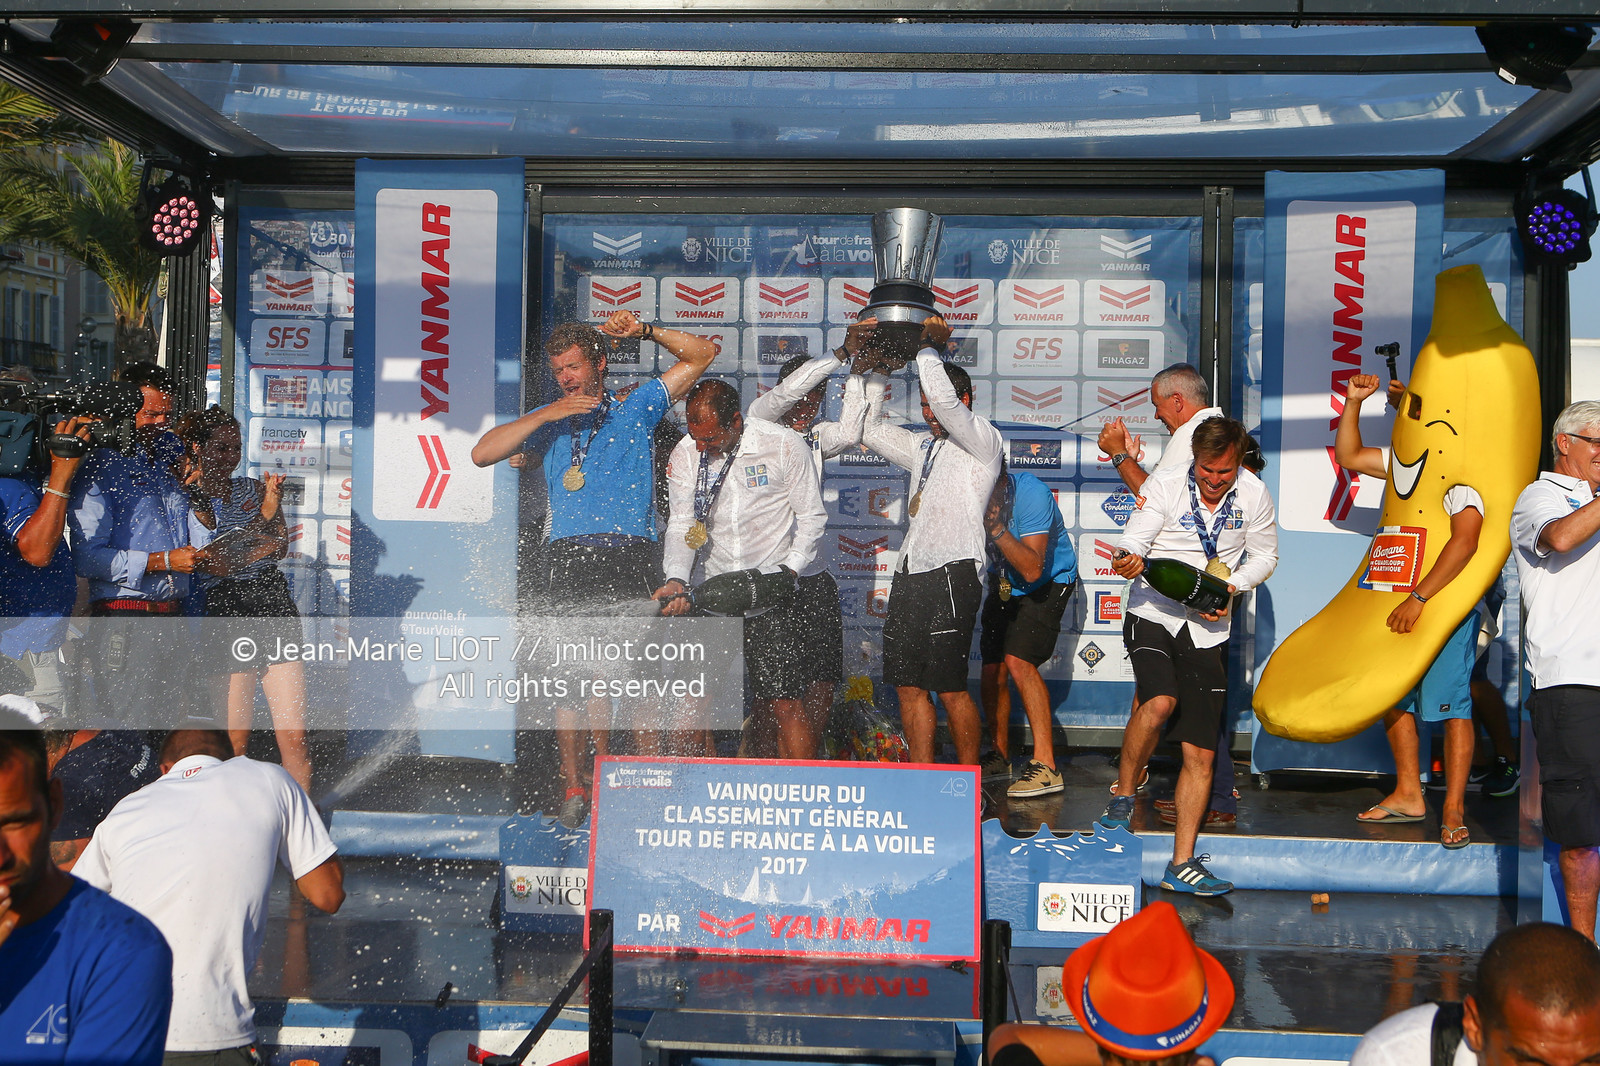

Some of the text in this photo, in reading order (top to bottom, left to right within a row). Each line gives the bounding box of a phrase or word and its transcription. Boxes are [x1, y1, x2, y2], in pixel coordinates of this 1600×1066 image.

[704, 238, 752, 247] VILLE DE
[1011, 239, 1060, 249] VILLE DE
[704, 248, 752, 263] NICE
[847, 248, 874, 261] voi
[1012, 249, 1060, 265] NICE
[592, 260, 642, 268] YANMAR
[1101, 263, 1151, 271] YANMAR
[265, 303, 313, 311] YANMAR
[421, 202, 450, 420] YANMAR
[675, 311, 725, 319] YANMAR
[759, 311, 809, 319] YANMAR
[1013, 313, 1064, 321] YANMAR
[1099, 313, 1150, 322] YANMAR
[265, 326, 311, 349] SFS
[1013, 337, 1063, 360] SFS
[940, 355, 974, 363] NAGAZ
[1102, 356, 1145, 365] FINAGAZ
[283, 401, 353, 417] FRANC
[1011, 414, 1062, 422] YANMAR
[261, 426, 308, 439] francetv
[261, 438, 306, 454] sport
[843, 454, 886, 463] FINAGAZ
[1014, 457, 1057, 465] FINAGAZ
[1104, 502, 1135, 511] Fondatio
[838, 563, 888, 572] YANMAR
[1094, 568, 1119, 576] YAN
[400, 623, 464, 636] @TourVoile
[642, 775, 673, 787] voile
[707, 782, 866, 805] VAINQUEUR DU
[664, 805, 909, 830] CLASSEMENT GÉNÉRAL
[635, 828, 935, 855] TOUR DE FRANCE À LA VOILE
[761, 856, 808, 875] 2017
[536, 875, 586, 887] VILLE D
[537, 888, 586, 907] NIC
[1071, 892, 1130, 905] VILLE DE
[1072, 904, 1130, 924] NICE
[637, 913, 931, 943] PAR YANMAR
[1169, 1015, 1202, 1045] FINAGAZ
